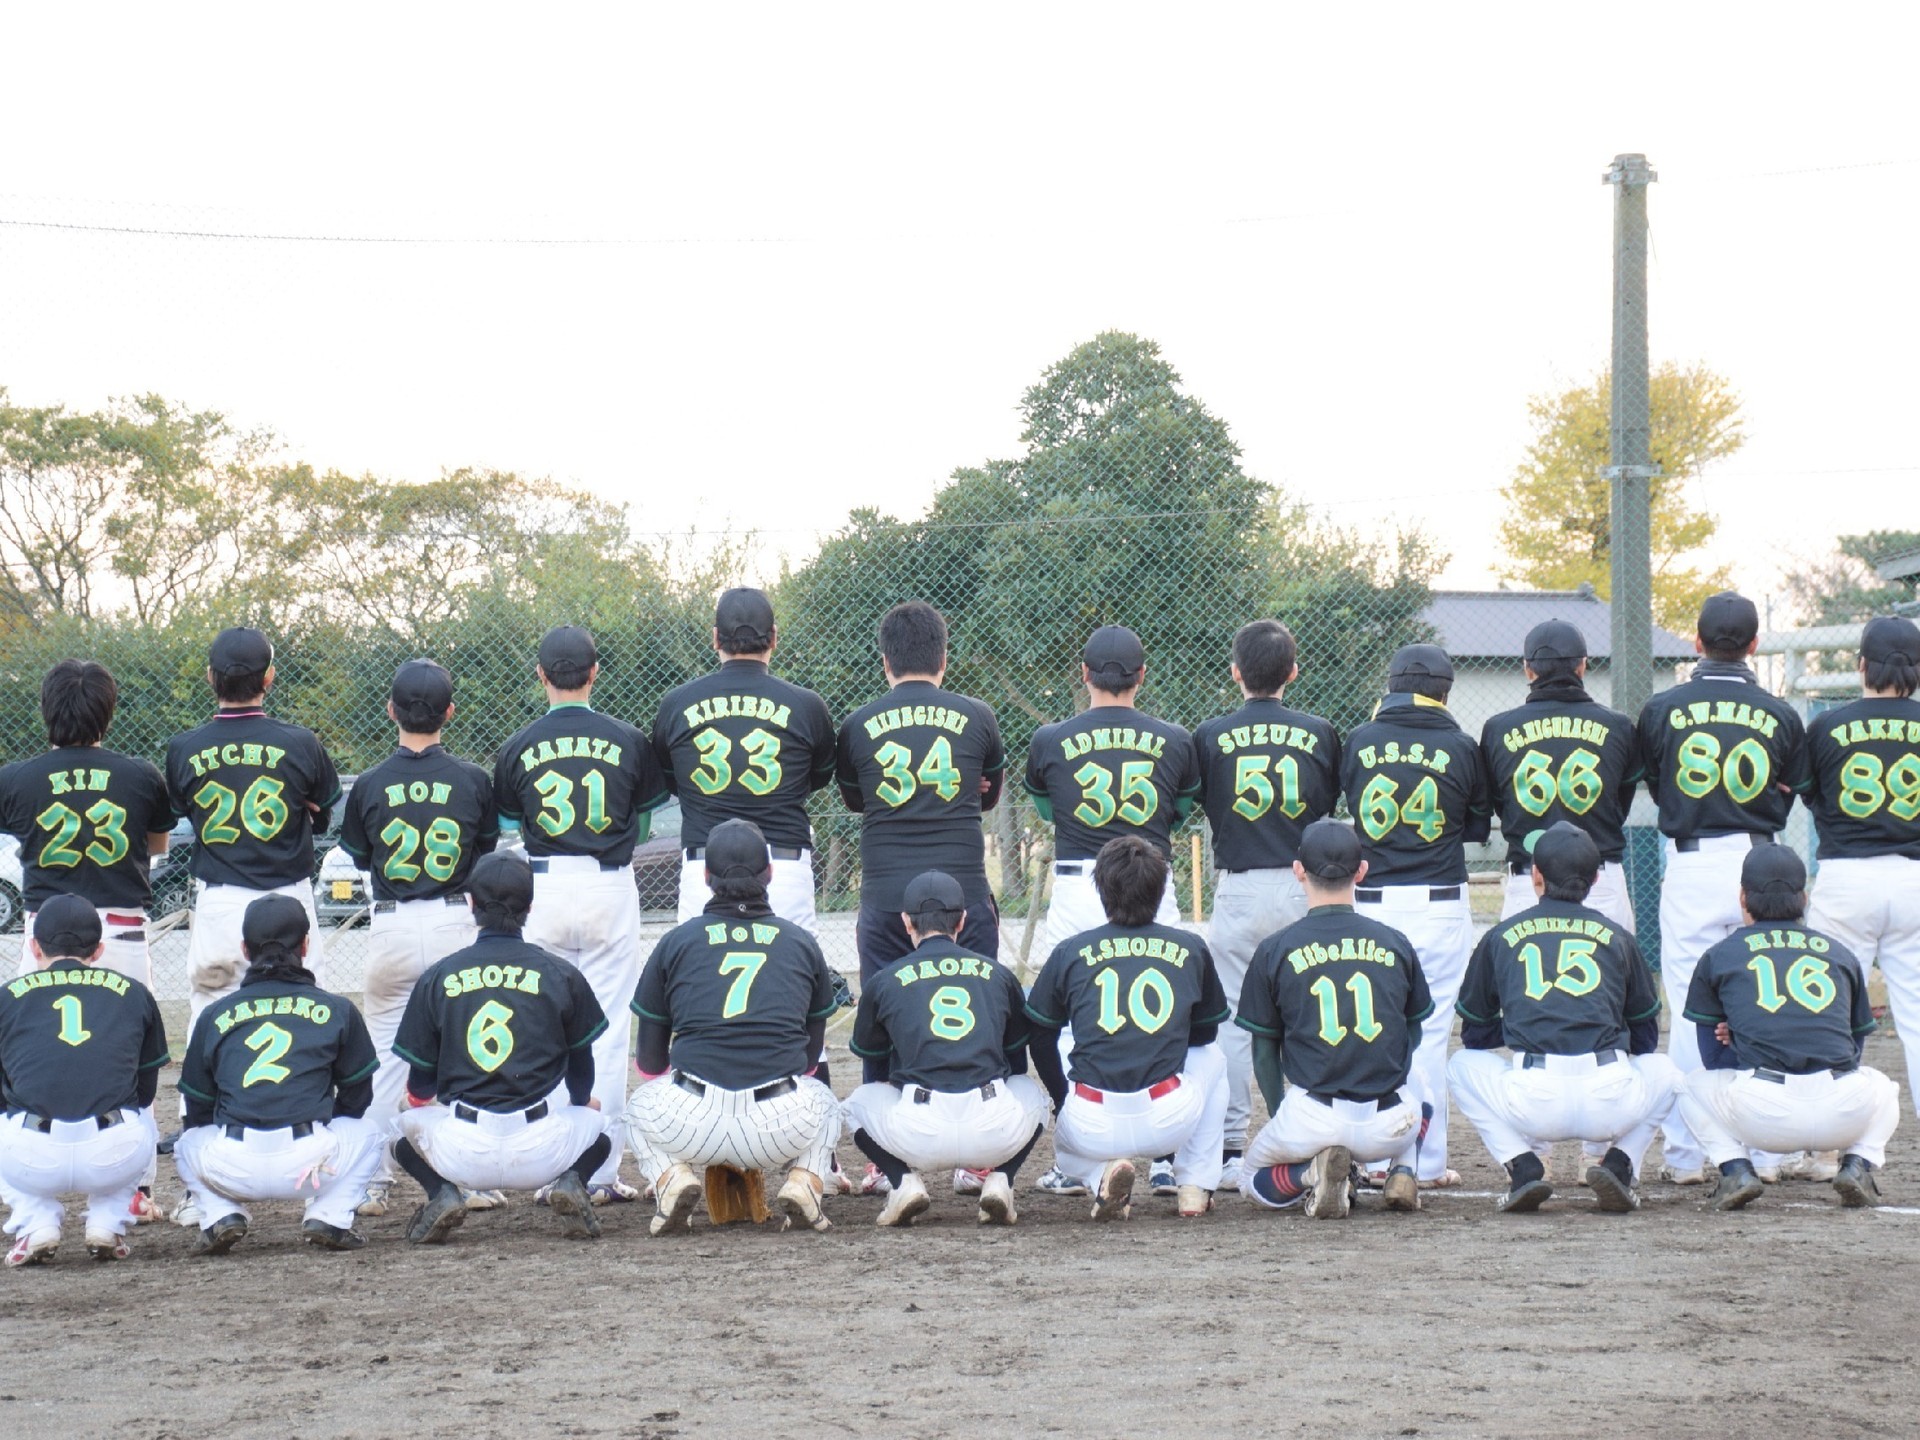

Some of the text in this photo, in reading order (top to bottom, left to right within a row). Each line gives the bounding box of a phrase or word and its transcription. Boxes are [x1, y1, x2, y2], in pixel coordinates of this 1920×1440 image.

[686, 695, 791, 728] KIRIEDA
[864, 705, 966, 738] MINEGISHI
[1219, 725, 1317, 754] SUZUKI
[1671, 702, 1778, 738] G.W.MASK
[190, 743, 285, 776] ITCHY
[521, 737, 621, 771] KANATA
[690, 727, 782, 795] 33
[874, 736, 961, 807] 34
[1062, 729, 1164, 759] ADMIRAL
[1676, 731, 1770, 803] 80
[49, 769, 111, 794] KIN
[194, 775, 288, 844] 26
[385, 781, 451, 806] NON
[534, 770, 612, 836] 31
[1074, 760, 1158, 827] 35
[1232, 755, 1306, 821] 51
[1359, 774, 1445, 842] 64
[1513, 747, 1603, 816] 66
[1839, 752, 1920, 821] 89
[36, 798, 129, 867] 23
[380, 817, 461, 882] 28
[1080, 937, 1187, 967] T.SHOHEI
[1502, 917, 1612, 946] NISHIKAWA
[1744, 930, 1828, 953] HIRO
[9, 970, 130, 998] MINEGISHI
[443, 965, 540, 997] SHOTA
[720, 952, 767, 1018] 7
[893, 957, 991, 986] NAOKI
[1518, 939, 1600, 1000] 15
[1747, 954, 1836, 1013] 16
[52, 994, 91, 1046] 1
[215, 996, 331, 1033] KANEKO
[929, 984, 975, 1040] 8
[1095, 967, 1174, 1034] 10
[1310, 972, 1383, 1046] 11
[242, 1022, 292, 1087] 2
[467, 999, 514, 1072] 6
